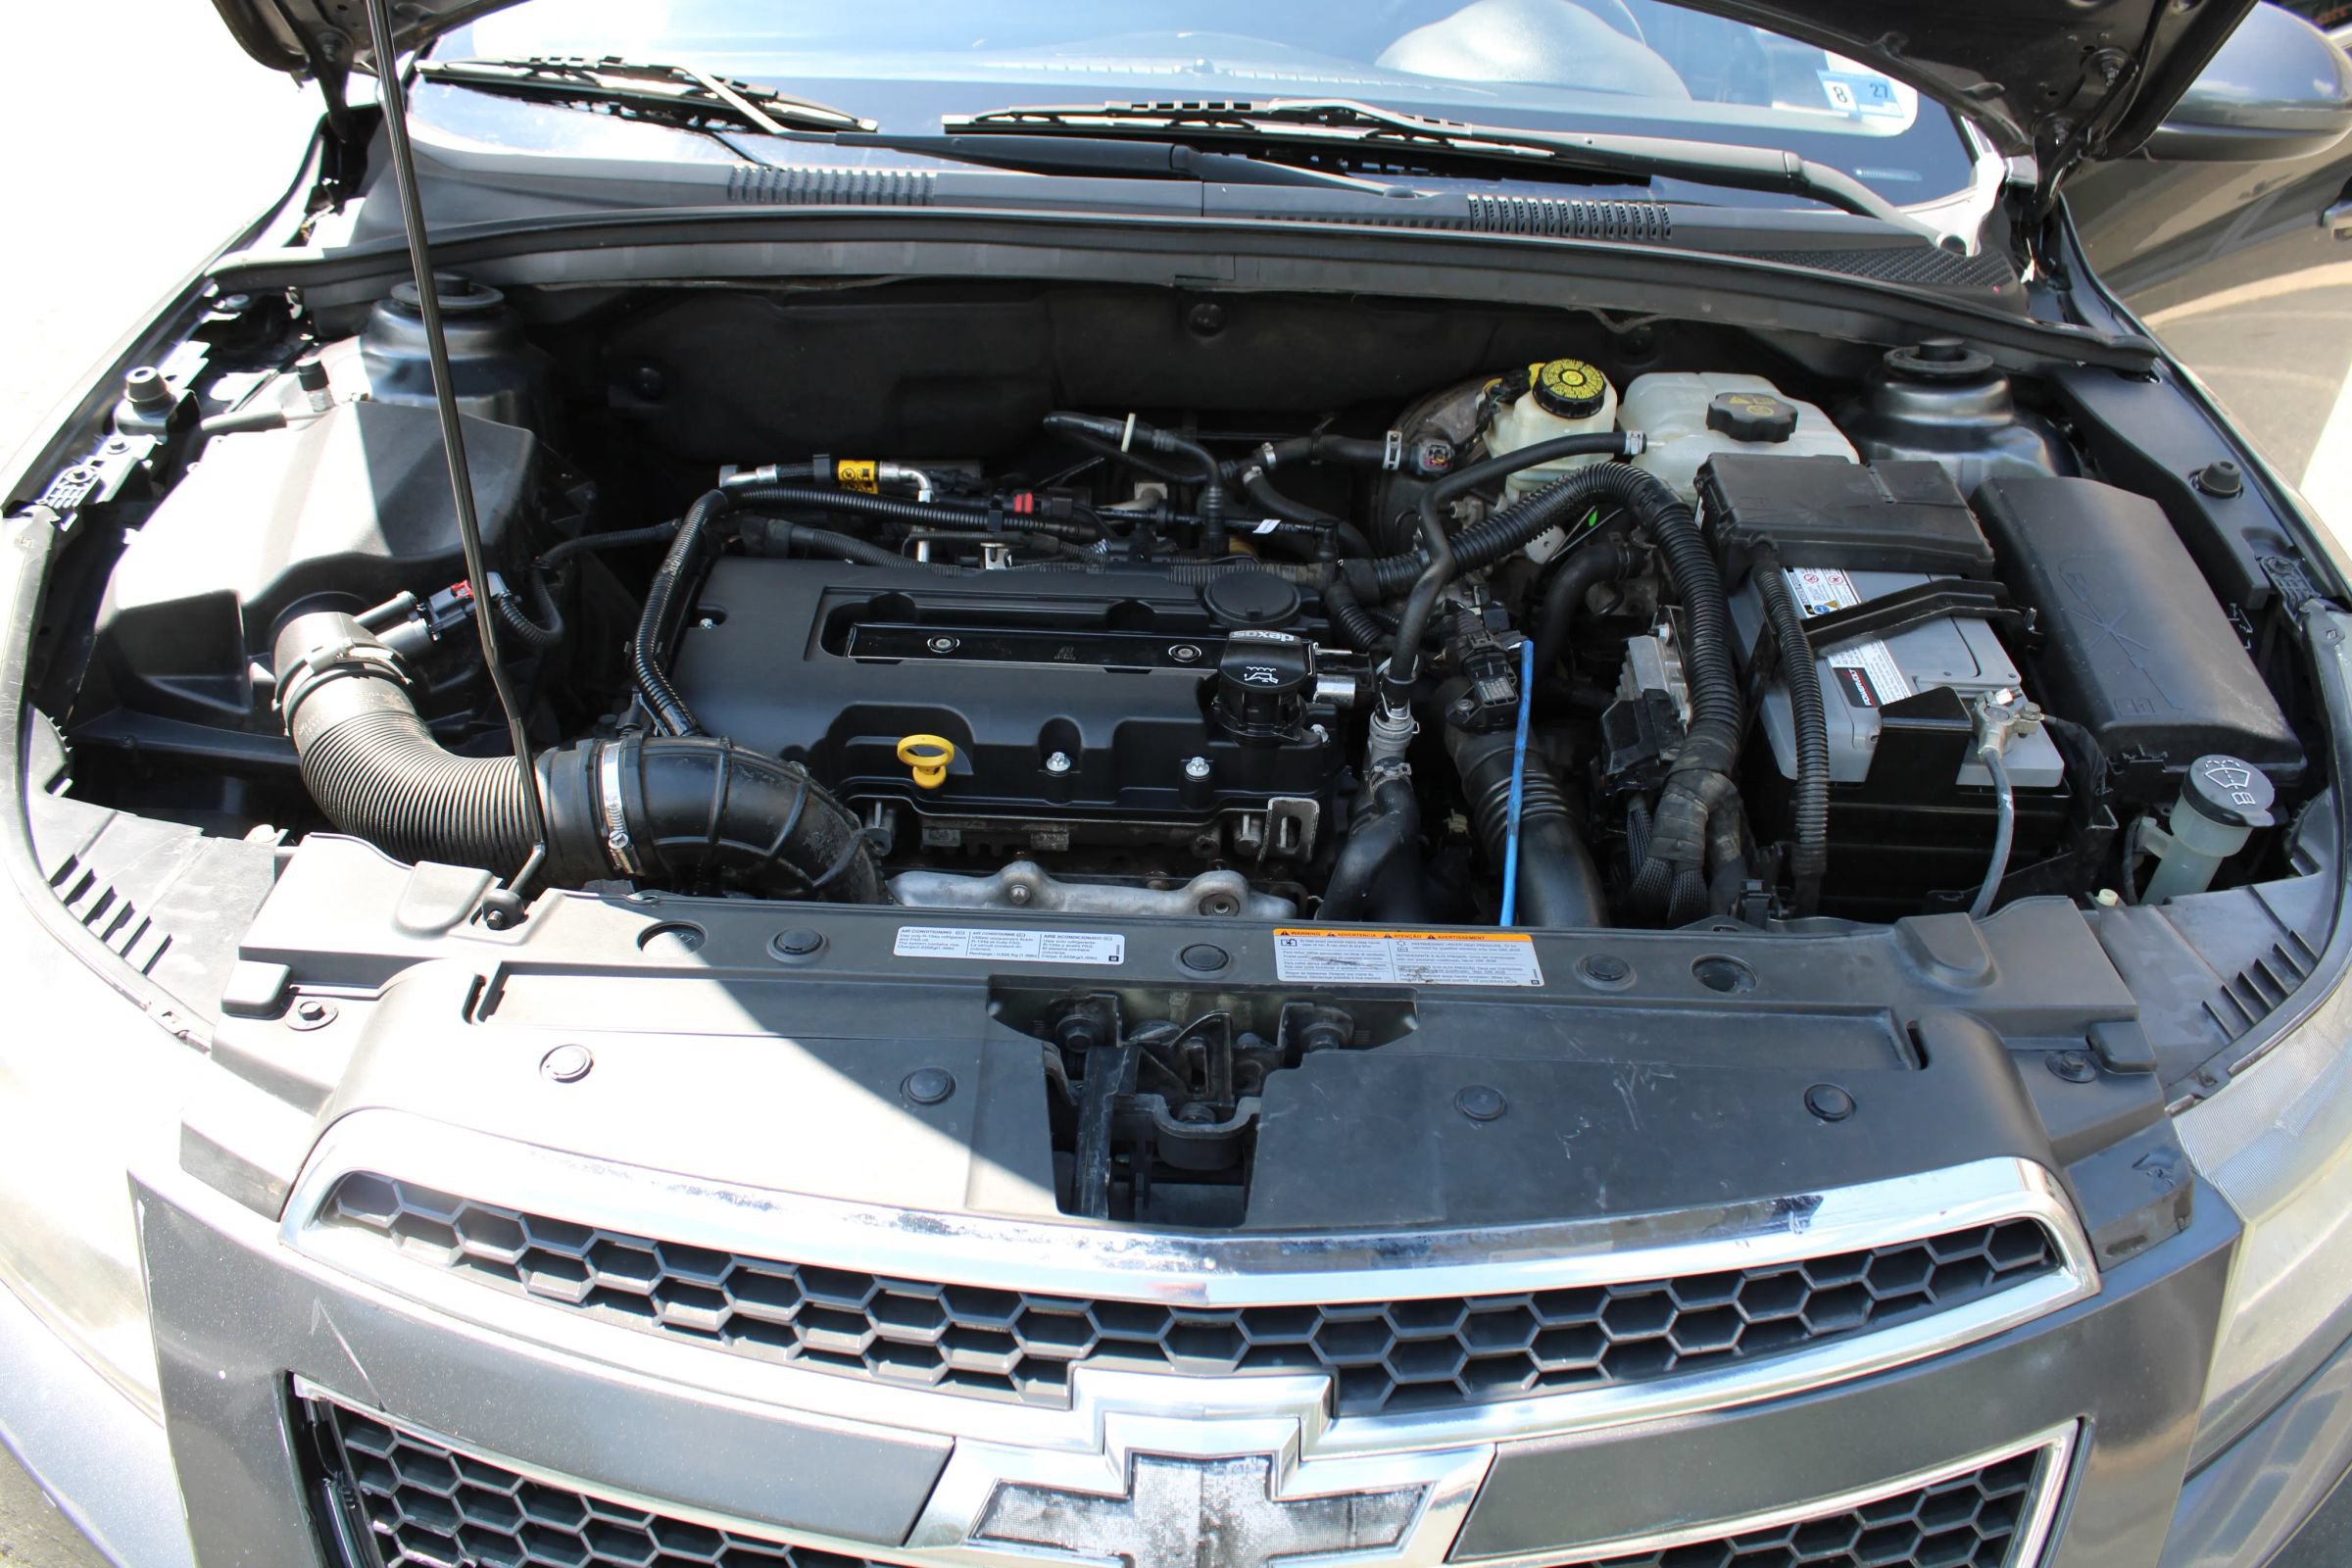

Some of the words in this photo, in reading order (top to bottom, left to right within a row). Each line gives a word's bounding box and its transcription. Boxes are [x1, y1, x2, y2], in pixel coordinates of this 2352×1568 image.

[1833, 85, 1848, 104] 8
[1869, 82, 1888, 99] 27
[1233, 630, 1295, 642] dexos
